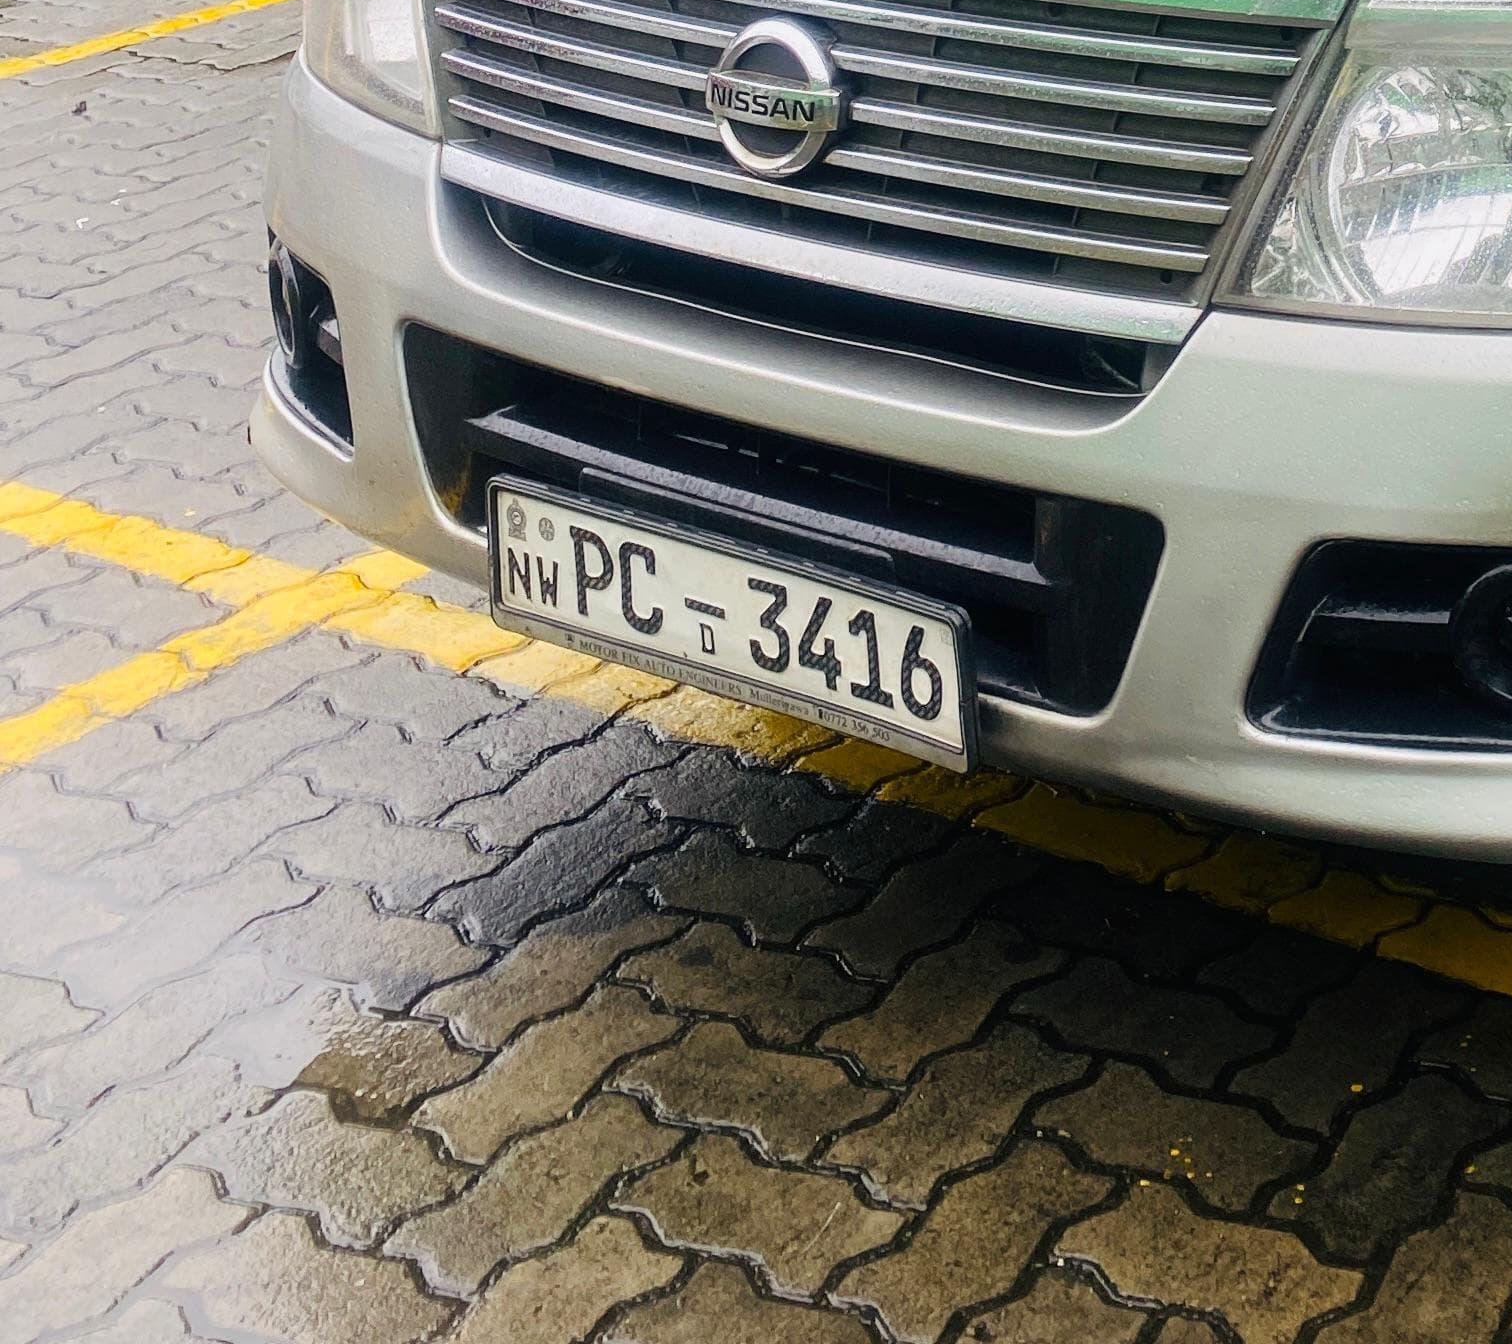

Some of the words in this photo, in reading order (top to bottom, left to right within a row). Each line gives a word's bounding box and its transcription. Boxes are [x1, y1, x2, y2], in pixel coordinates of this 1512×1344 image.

[711, 85, 816, 122] NISSAN
[507, 547, 559, 609] NW
[579, 640, 619, 662] MOTOR
[622, 651, 641, 668] FIX
[645, 659, 676, 677] AUTO
[678, 668, 743, 696] ENGINEERS
